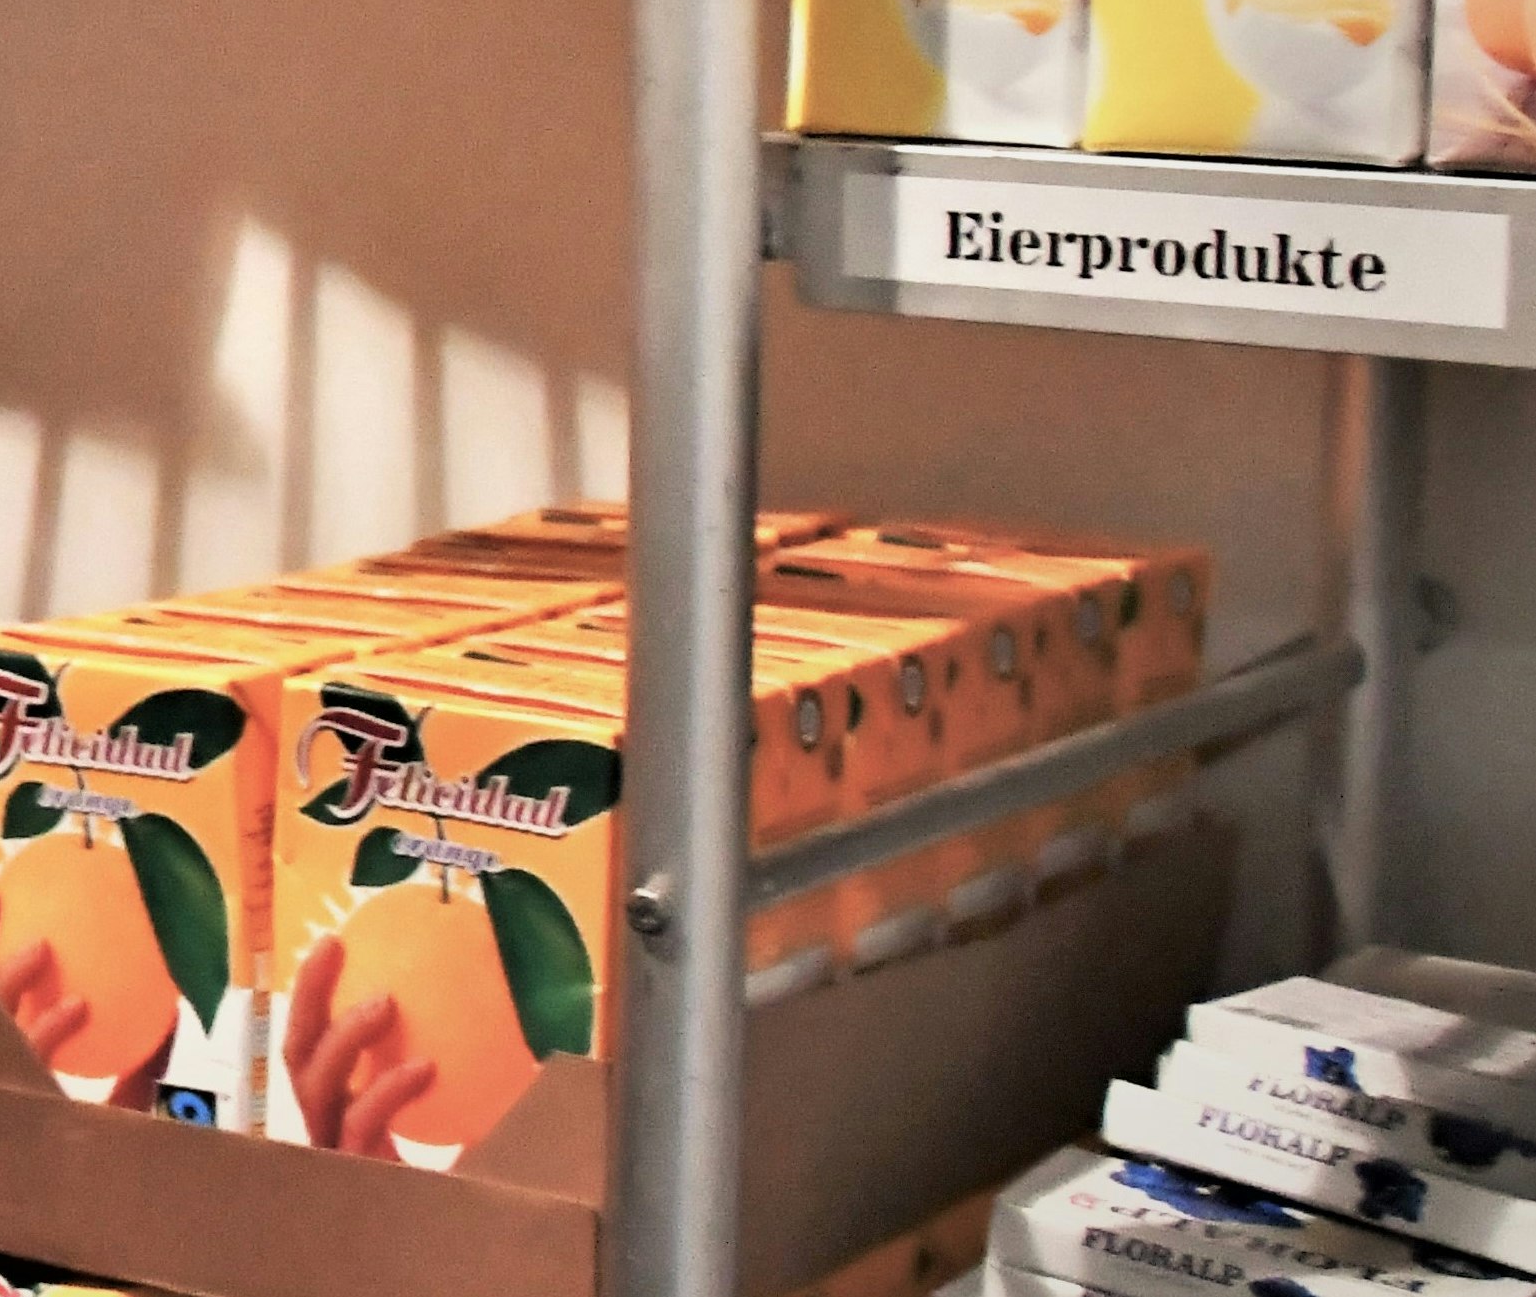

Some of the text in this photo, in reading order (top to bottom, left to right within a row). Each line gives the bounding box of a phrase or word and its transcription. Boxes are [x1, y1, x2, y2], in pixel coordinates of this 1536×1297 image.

[943, 209, 1387, 295] Eierprodukte
[296, 706, 572, 840] Felicidad
[1247, 1070, 1408, 1131] FLORALP
[1197, 1103, 1352, 1168] FLORALP
[1082, 1226, 1246, 1287] FLORALP
